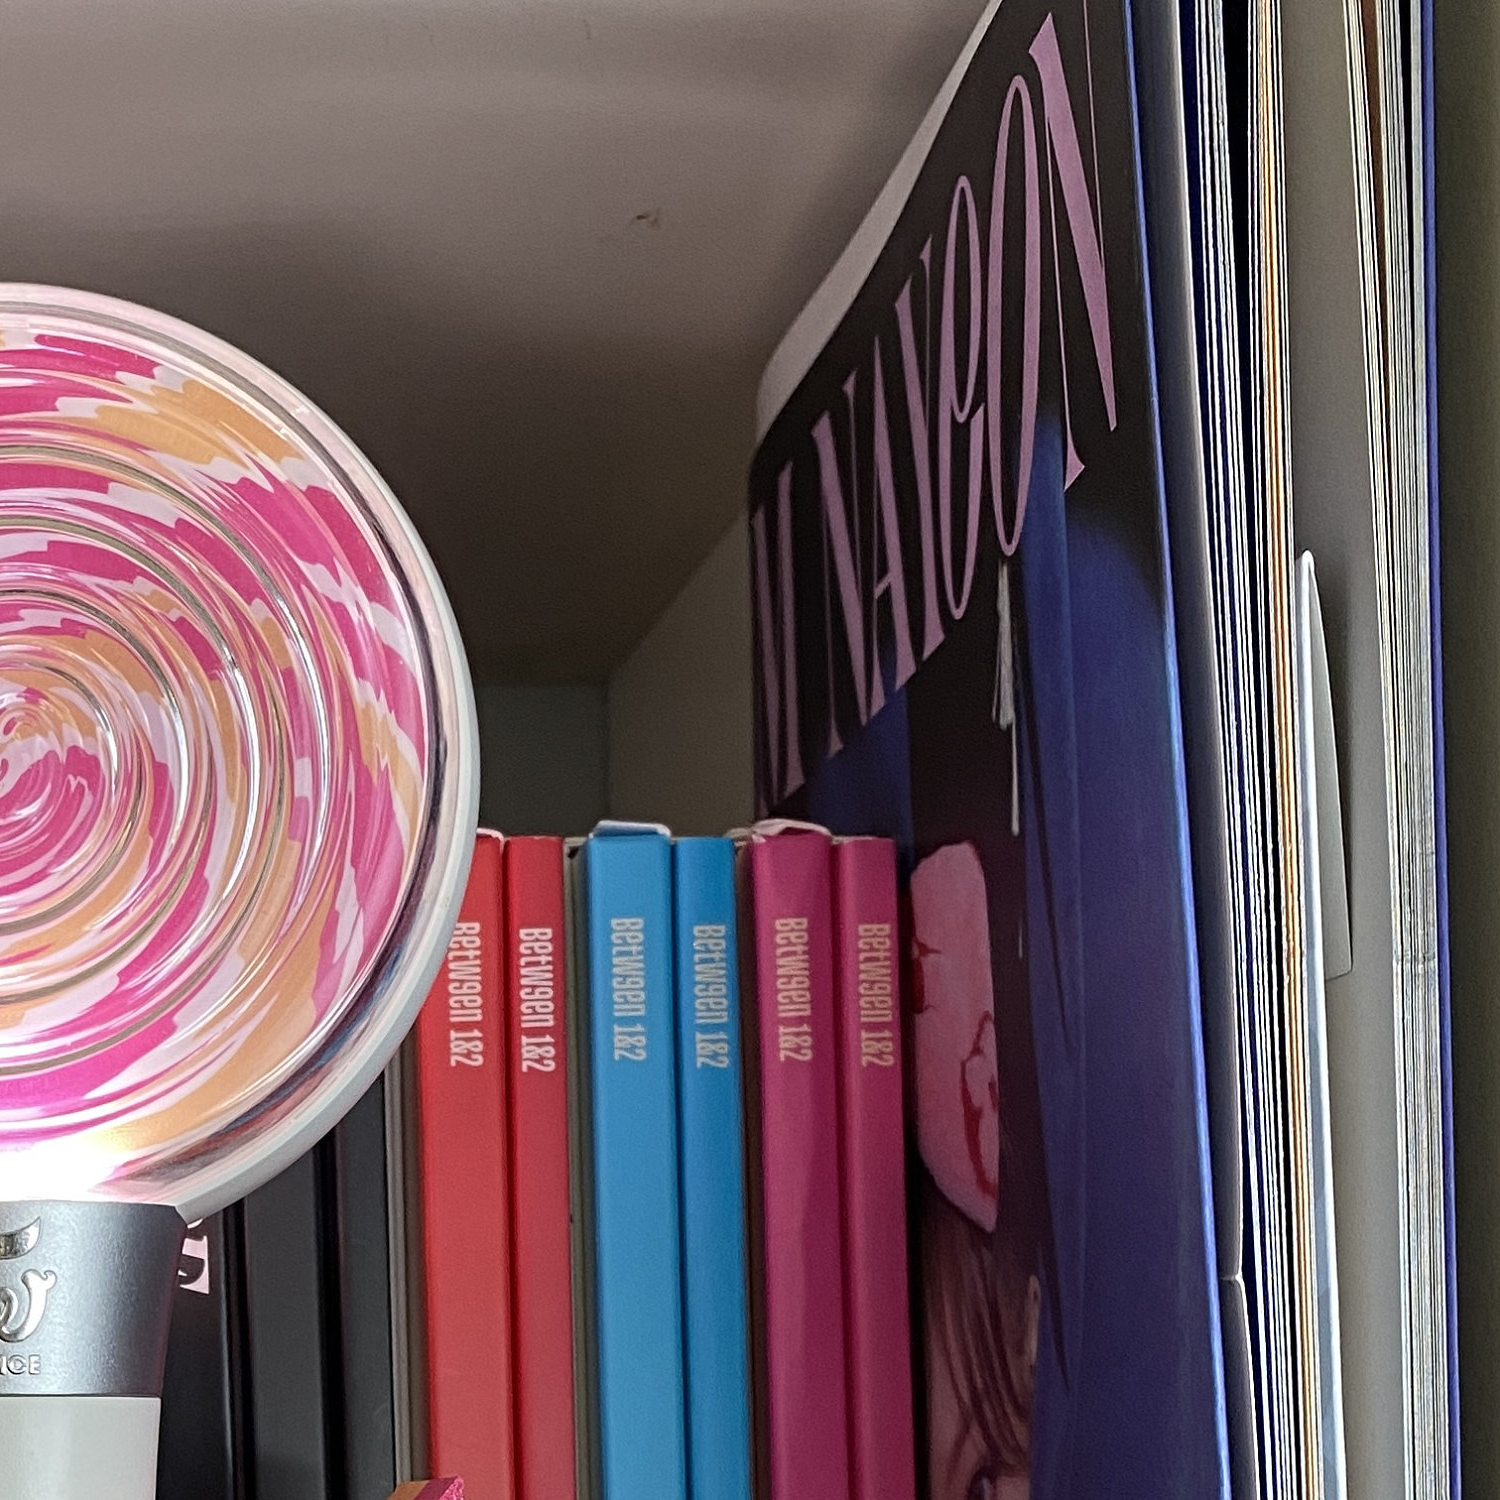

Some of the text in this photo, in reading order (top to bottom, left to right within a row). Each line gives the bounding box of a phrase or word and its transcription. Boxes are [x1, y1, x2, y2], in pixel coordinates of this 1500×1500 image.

[450, 1029, 484, 1067] 1&2
[520, 1034, 556, 1073] 1&2
[613, 1023, 647, 1061] 1&2
[695, 1031, 730, 1069] 1&2
[778, 1023, 813, 1063] 1&2
[861, 1029, 895, 1068] 1&2
